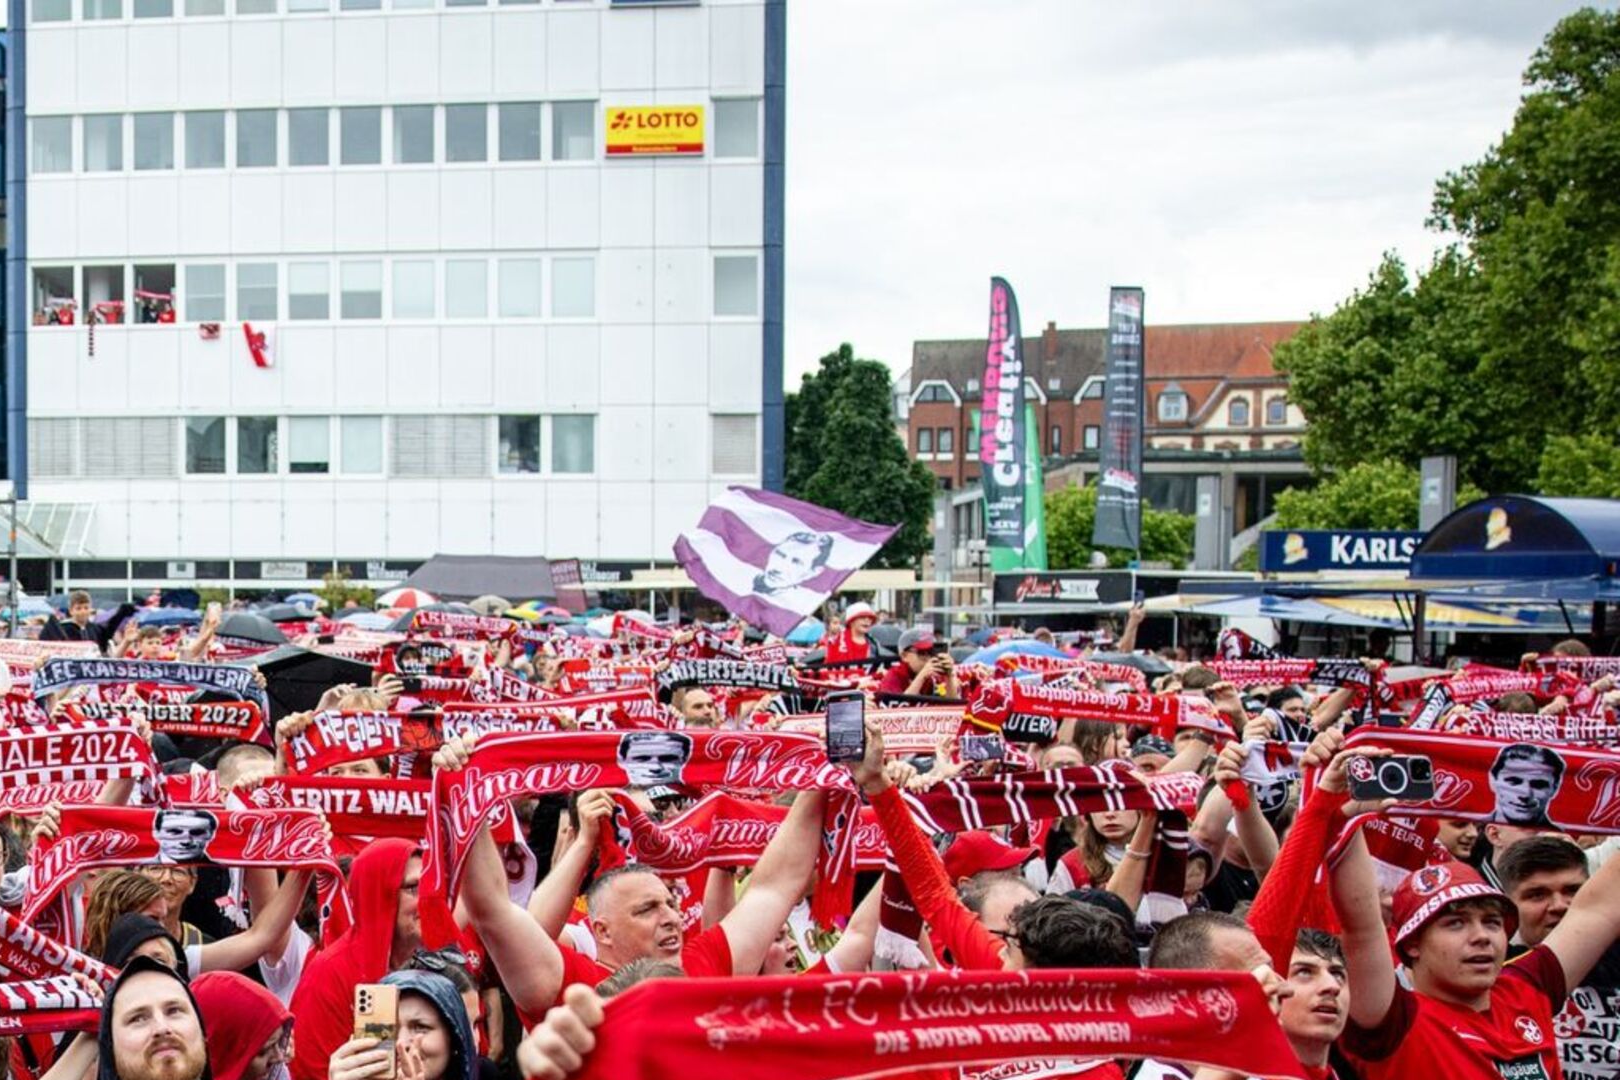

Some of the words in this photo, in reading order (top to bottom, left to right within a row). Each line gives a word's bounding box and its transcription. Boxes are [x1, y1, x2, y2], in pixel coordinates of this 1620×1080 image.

[637, 112, 698, 129] LOTTO
[200, 704, 251, 727] 2022
[70, 731, 139, 767] 2024
[290, 787, 362, 814] FRITZ
[1390, 827, 1426, 850] TEUFEL
[7, 949, 41, 975] WAS
[819, 978, 882, 1028] FC
[874, 1026, 910, 1054] DIE
[916, 1023, 983, 1049] ROTEN
[985, 1021, 1048, 1045] TEUFEL
[1049, 1021, 1131, 1044] KOMMEN
